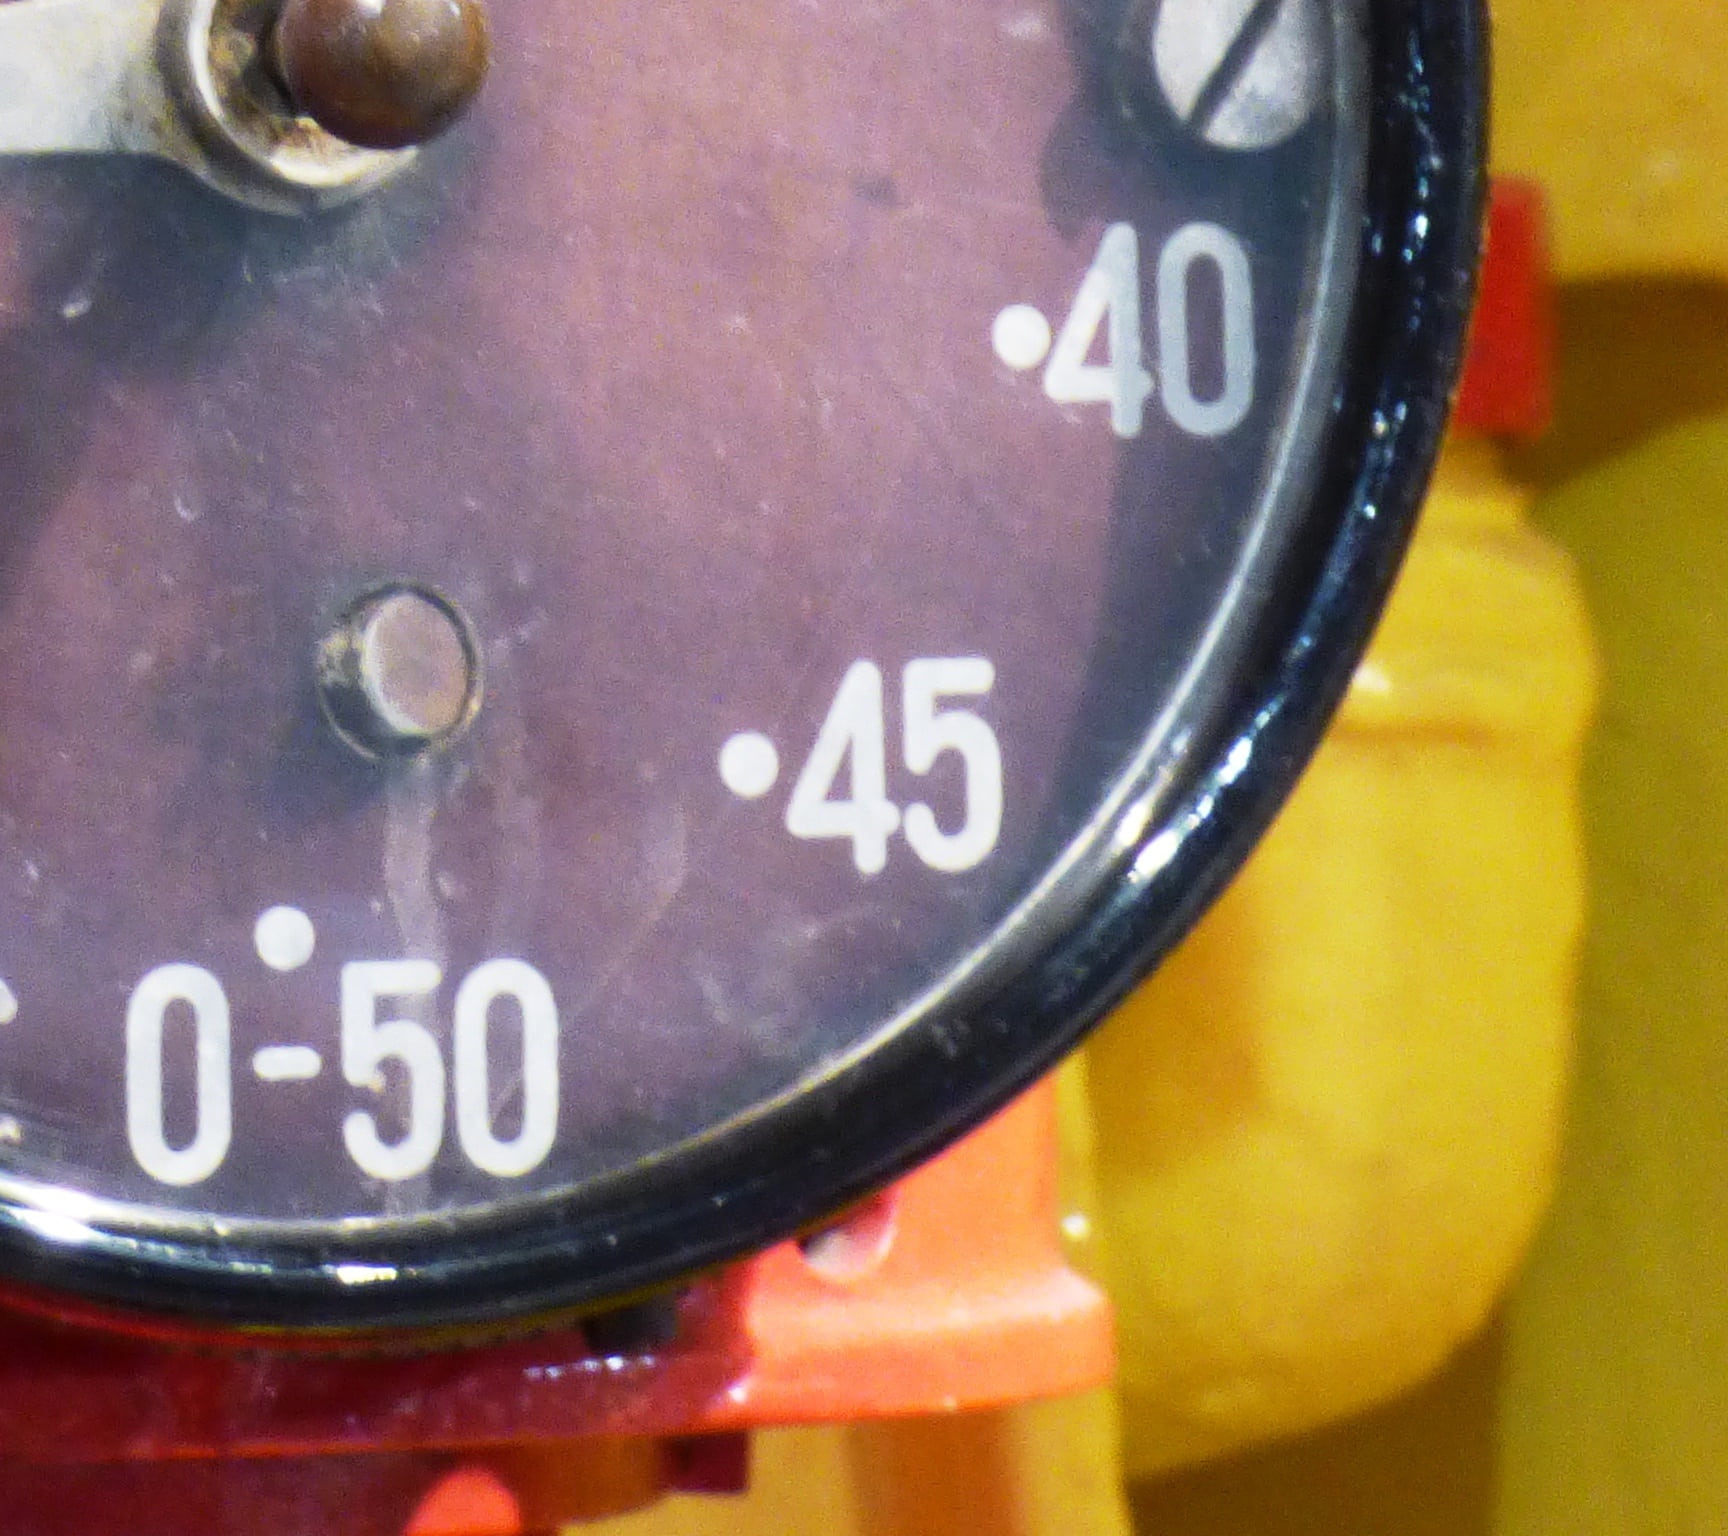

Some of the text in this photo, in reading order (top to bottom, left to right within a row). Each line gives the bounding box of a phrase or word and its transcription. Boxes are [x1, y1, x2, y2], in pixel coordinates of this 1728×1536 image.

[1043, 220, 1256, 439] 40
[786, 656, 1004, 874] 45
[124, 956, 560, 1186] 0-50
